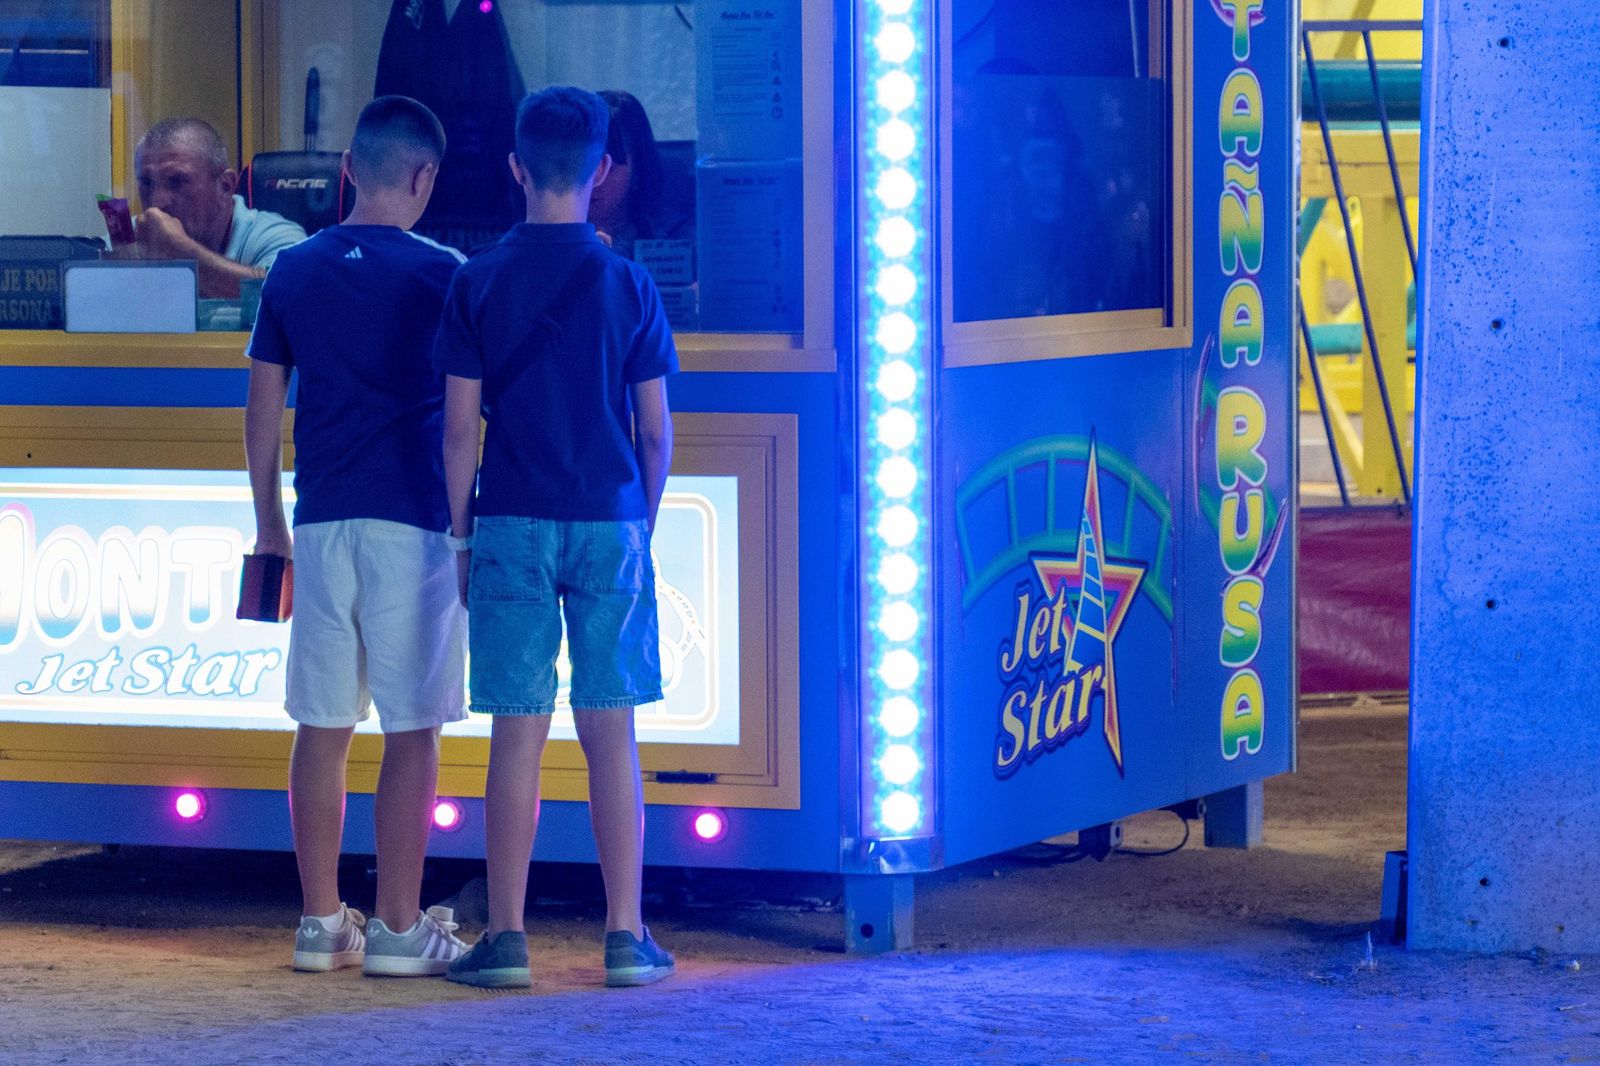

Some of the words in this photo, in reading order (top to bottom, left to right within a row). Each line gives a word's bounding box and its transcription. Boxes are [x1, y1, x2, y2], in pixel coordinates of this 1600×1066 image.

[24, 268, 58, 292] POR
[1216, 385, 1268, 761] RUSA
[15, 645, 123, 695] Jet
[121, 643, 282, 696] Star
[1001, 584, 1068, 673] Jet
[997, 664, 1104, 767] Star
